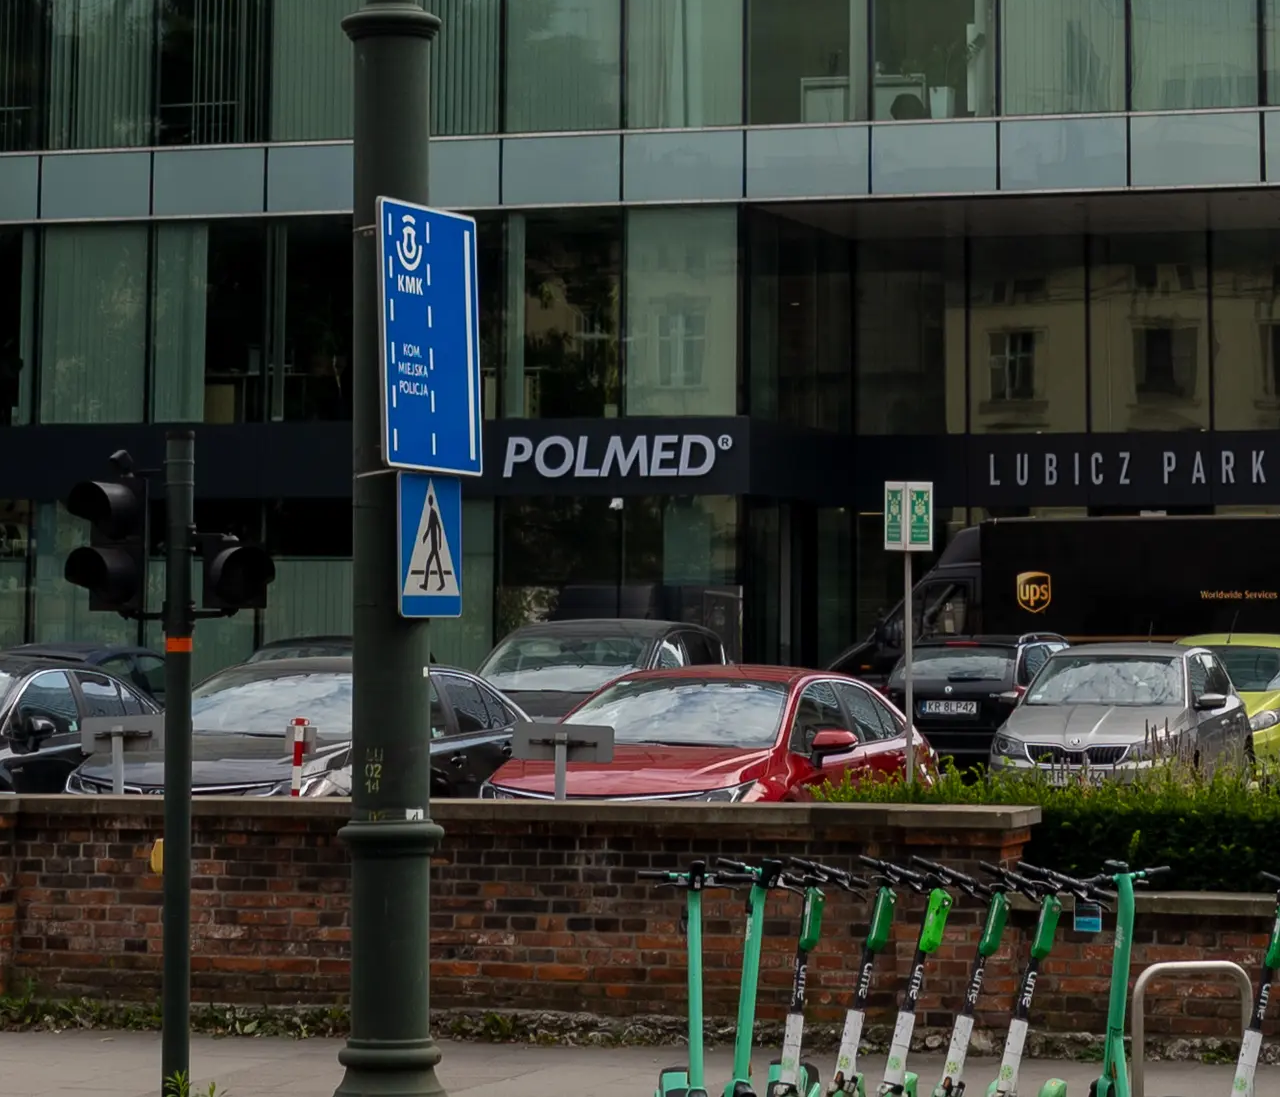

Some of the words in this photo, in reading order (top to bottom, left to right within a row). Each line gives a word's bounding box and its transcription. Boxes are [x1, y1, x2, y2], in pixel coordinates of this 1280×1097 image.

[398, 274, 423, 295] KMK
[403, 343, 422, 358] KOM.
[398, 361, 428, 378] MIEJSKA
[400, 380, 428, 397] POLICJA
[990, 452, 1131, 485] LUBICZ
[1163, 450, 1266, 484] PARK
[1200, 590, 1242, 599] Worldwide
[1244, 590, 1278, 599] Services
[928, 702, 941, 712] KR
[365, 764, 382, 778] 02
[365, 780, 380, 794] 14
